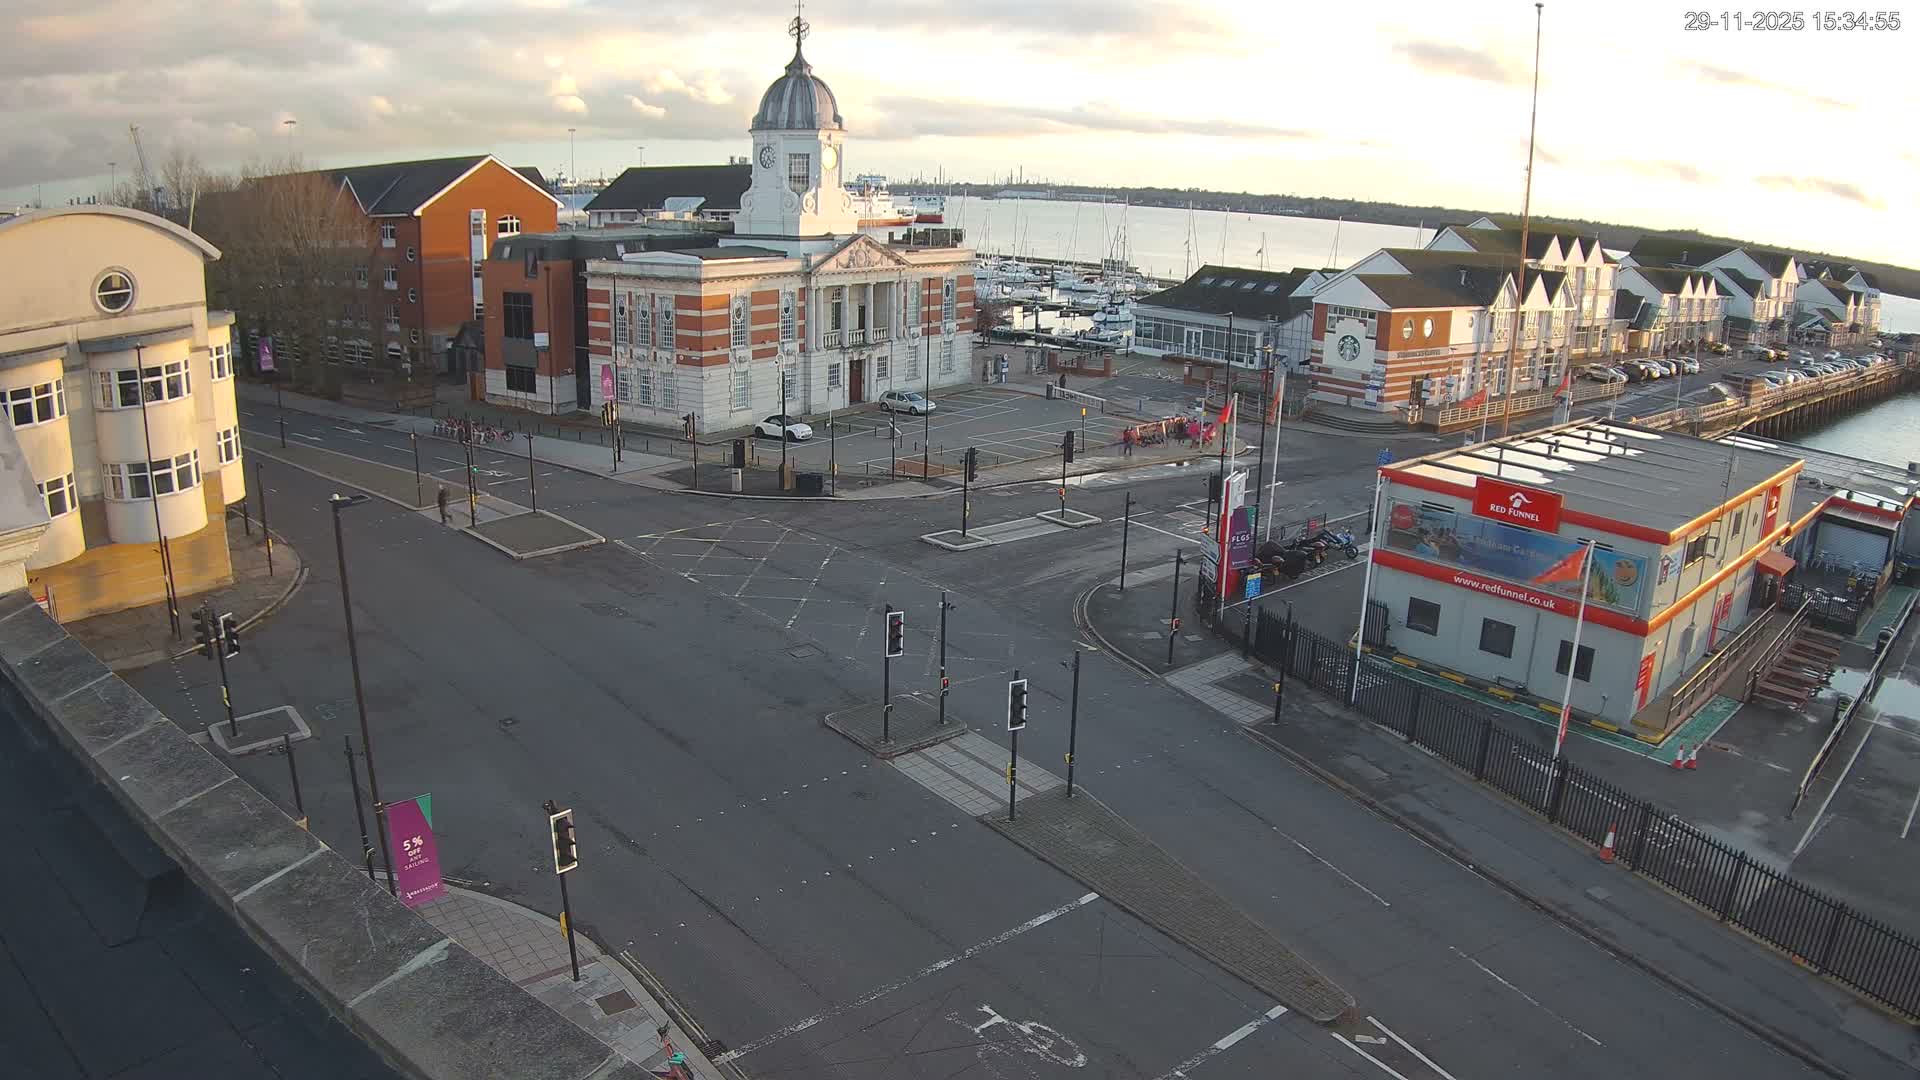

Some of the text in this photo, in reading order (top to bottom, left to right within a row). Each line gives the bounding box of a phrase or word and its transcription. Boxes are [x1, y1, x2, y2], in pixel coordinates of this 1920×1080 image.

[1489, 503, 1540, 522] RED FUNNEL
[1453, 574, 1556, 610] www.redfunnel.co.uk
[408, 848, 421, 856] OFF
[404, 857, 429, 870] SAILING
